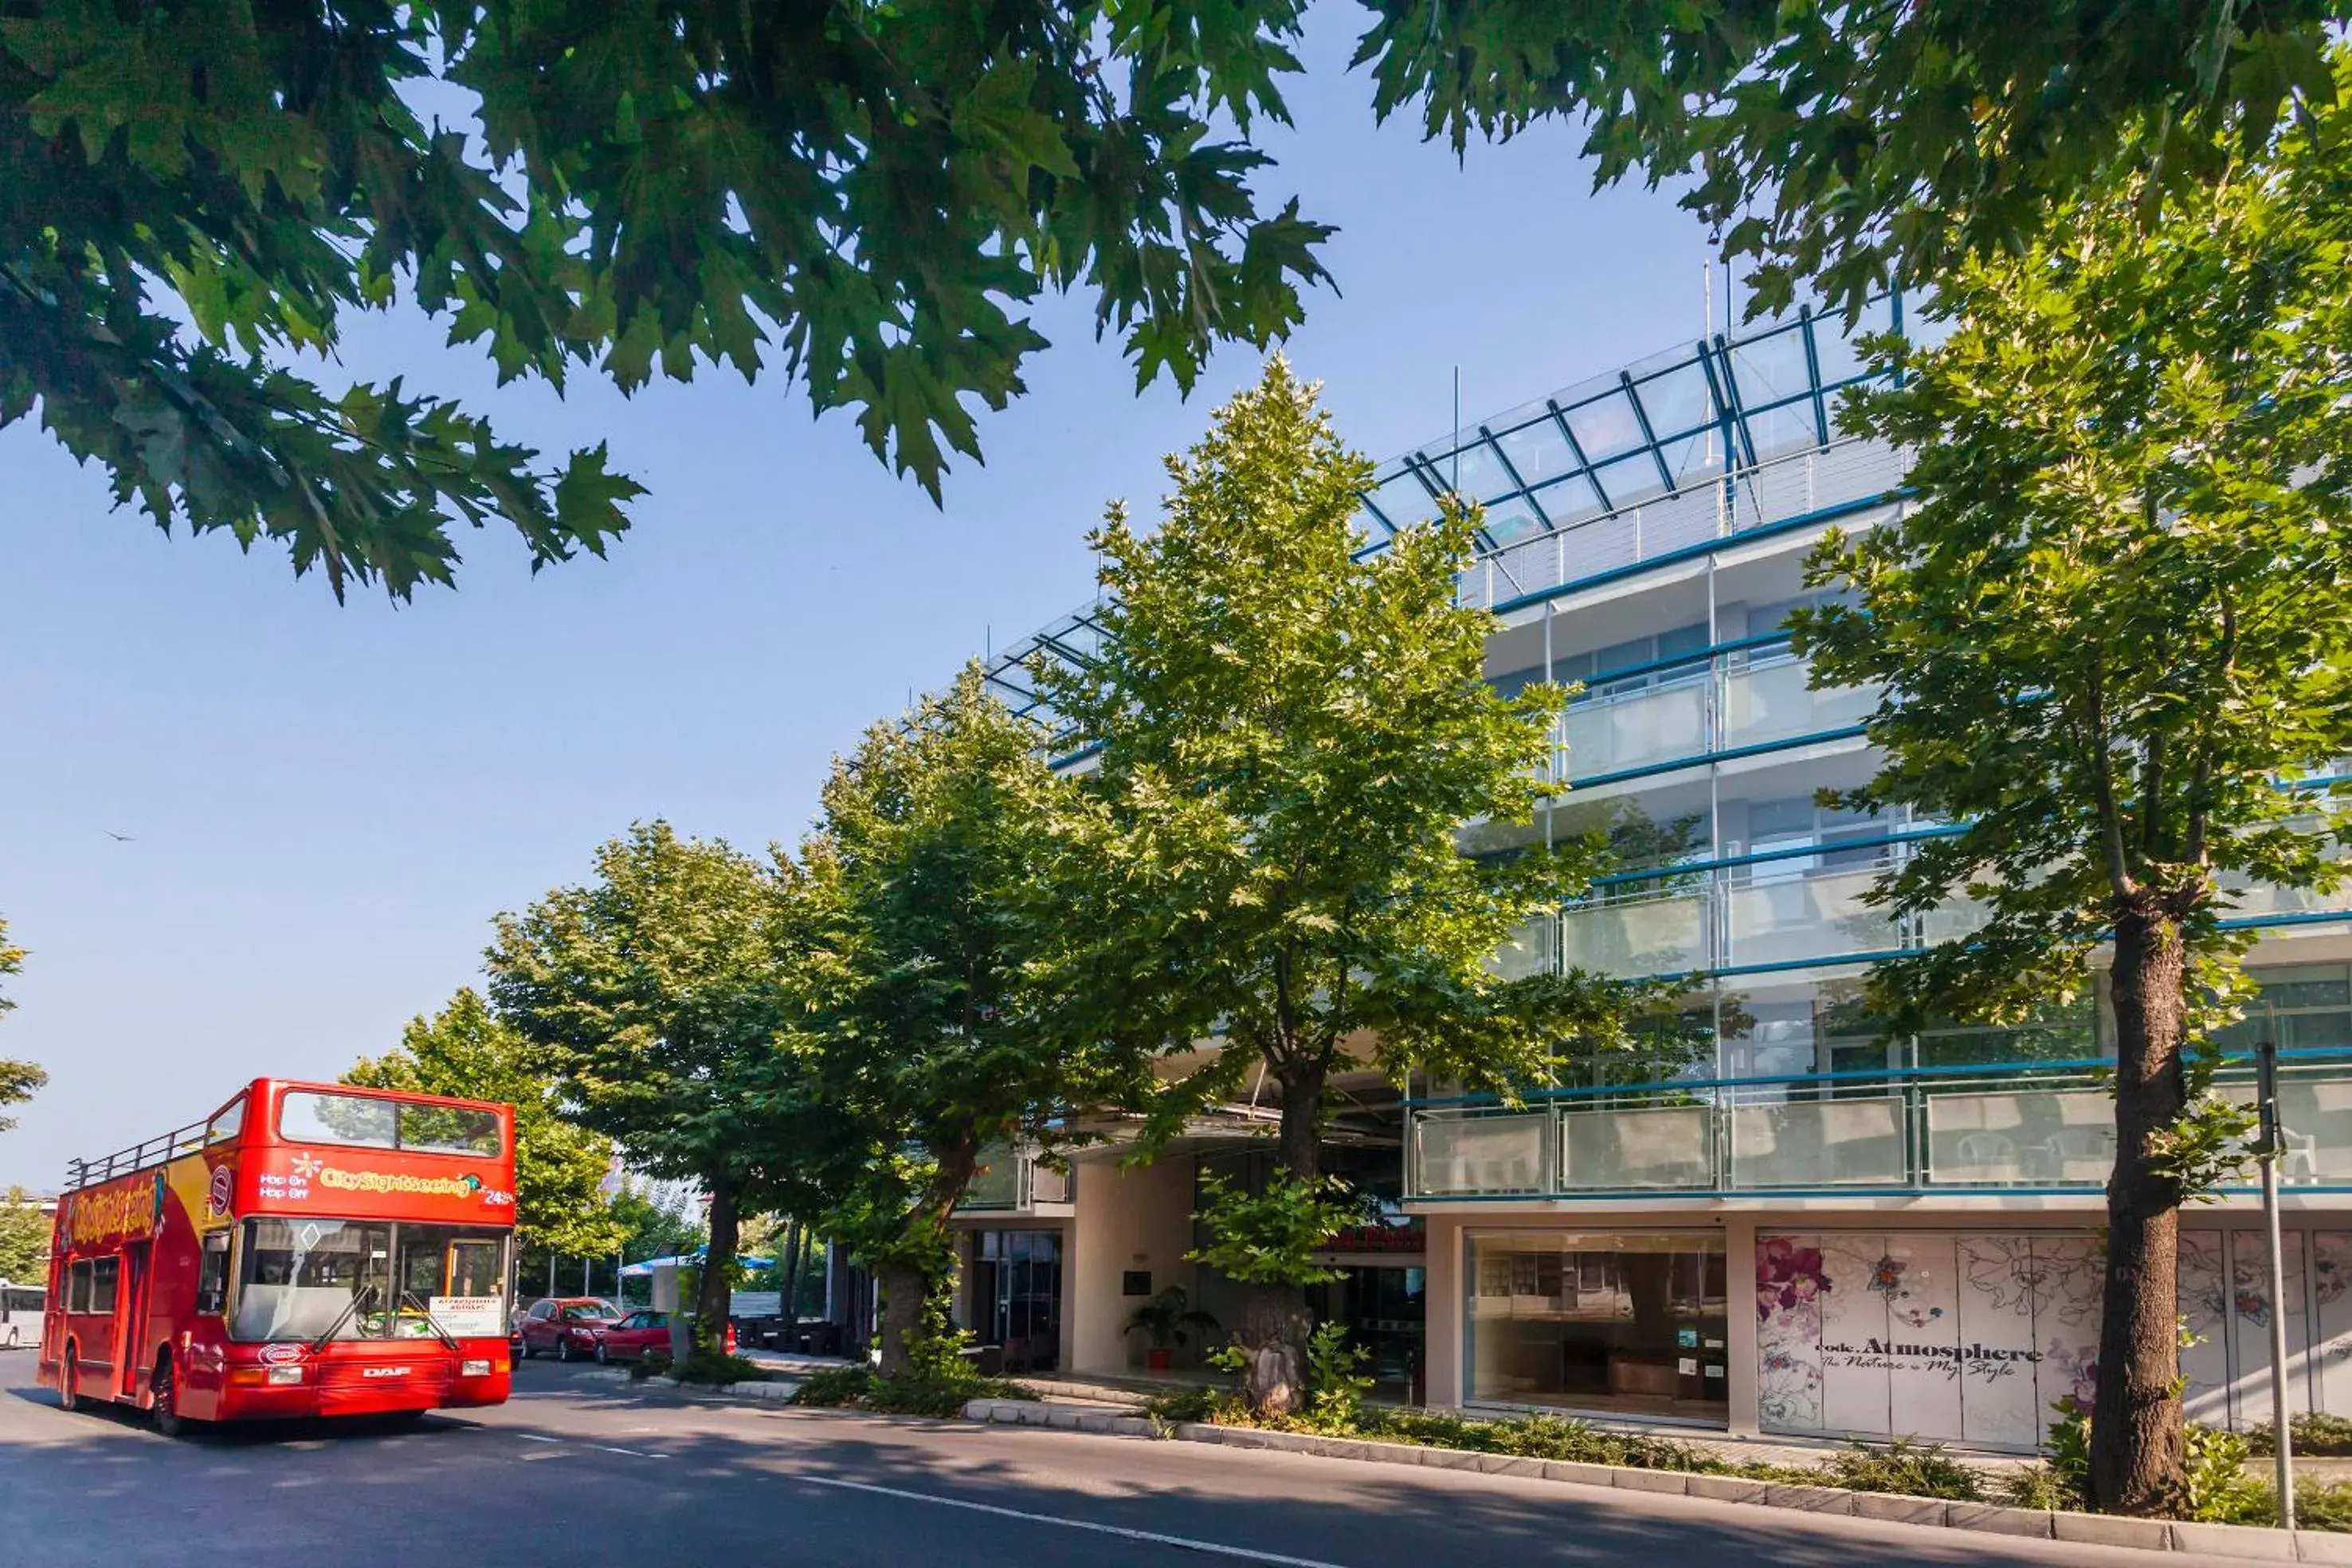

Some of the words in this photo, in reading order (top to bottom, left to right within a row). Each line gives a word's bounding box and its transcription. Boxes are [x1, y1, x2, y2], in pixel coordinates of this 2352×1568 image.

[260, 1174, 286, 1186] Hop
[288, 1175, 307, 1187] On
[259, 1187, 285, 1199] Hop
[288, 1187, 309, 1200] Off
[1861, 1337, 2044, 1363] Atmosphere
[363, 1367, 411, 1378] DAF
[1845, 1354, 1906, 1370] Nature
[1923, 1359, 1959, 1380] My
[1967, 1360, 2016, 1383] Style
